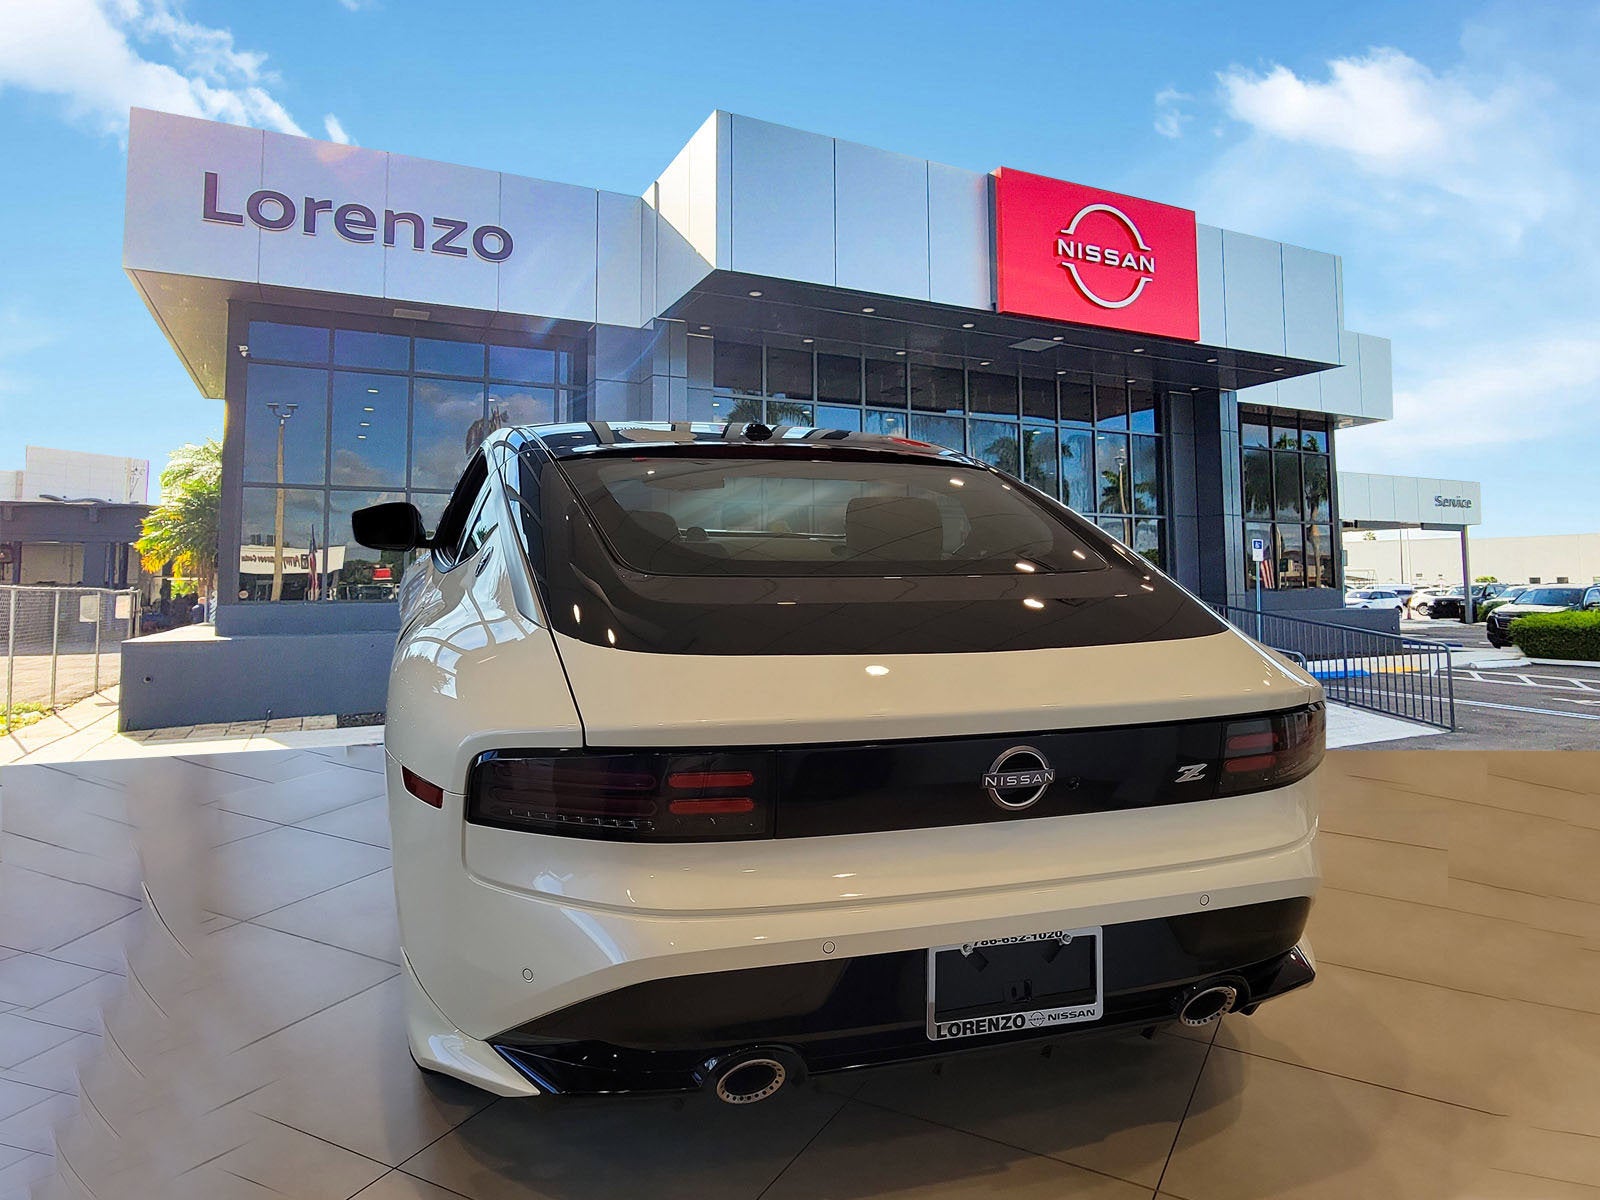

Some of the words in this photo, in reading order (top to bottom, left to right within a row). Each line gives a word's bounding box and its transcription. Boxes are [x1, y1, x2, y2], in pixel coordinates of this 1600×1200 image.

[203, 171, 514, 263] Lorenzo
[1057, 238, 1155, 273] NISSAN
[1434, 495, 1472, 509] Service
[984, 771, 1055, 787] NISSAN
[936, 1014, 1026, 1039] LORENZO
[1047, 1009, 1096, 1021] NISSAN
